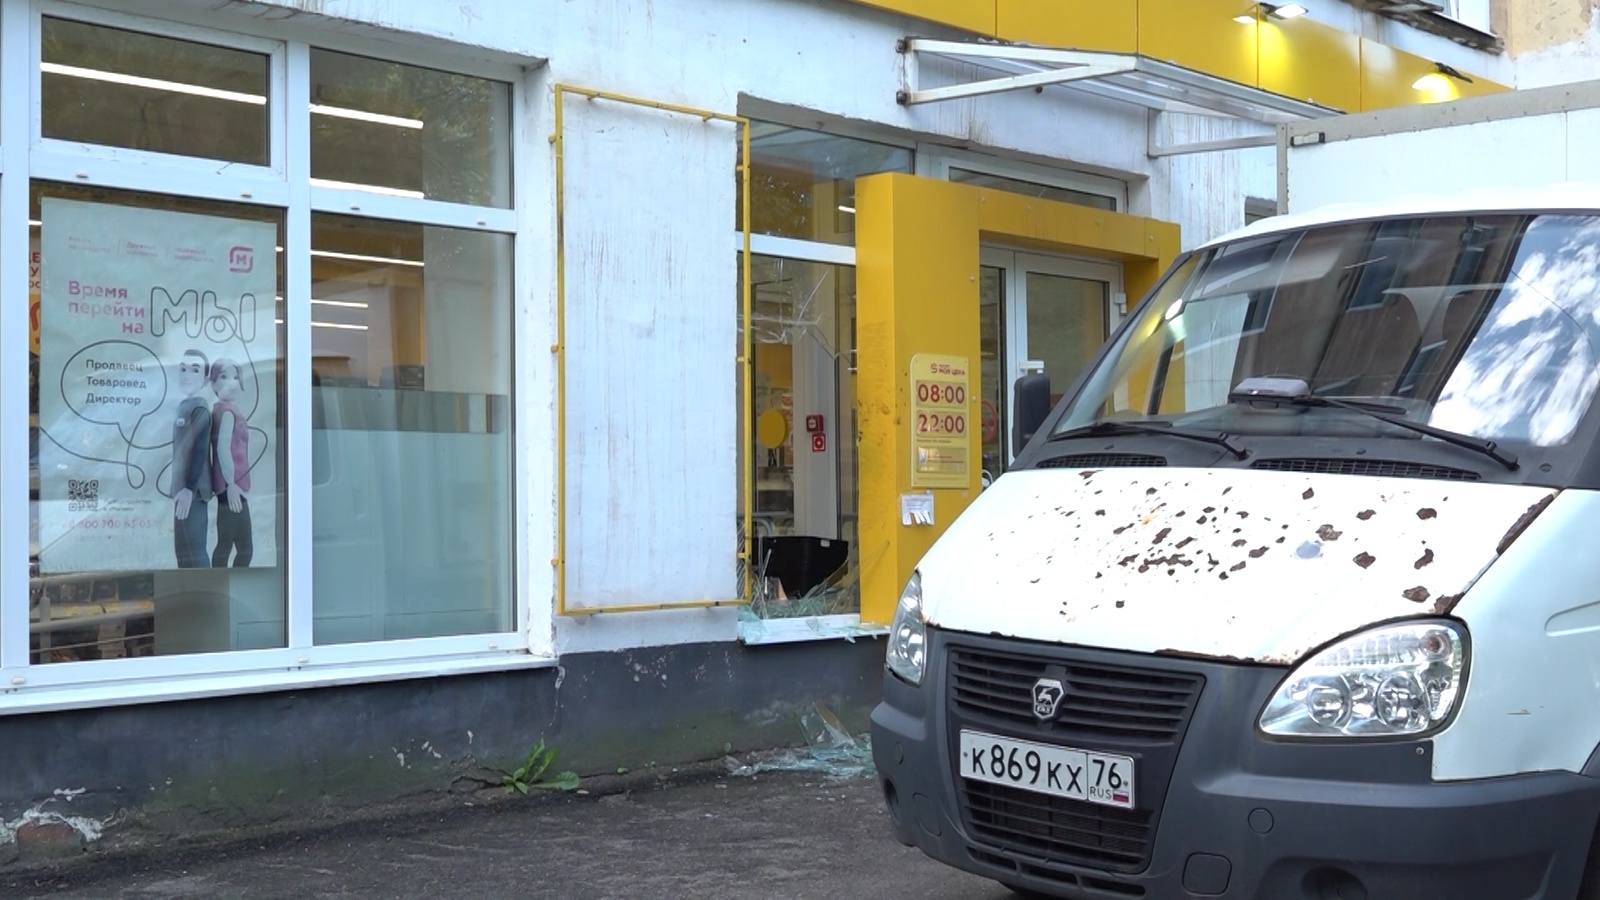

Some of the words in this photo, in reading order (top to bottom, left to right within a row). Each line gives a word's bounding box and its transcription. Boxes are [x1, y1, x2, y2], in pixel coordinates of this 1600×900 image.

[68, 280, 128, 299] Время
[68, 301, 145, 318] перейти
[122, 322, 144, 334] на
[86, 359, 143, 373] Продавец
[86, 376, 147, 390] Товаровед
[85, 392, 141, 406] Директор
[918, 383, 965, 404] 08:00
[918, 413, 965, 434] 22:00
[1092, 759, 1122, 789] 76
[1090, 785, 1113, 800] RUS
